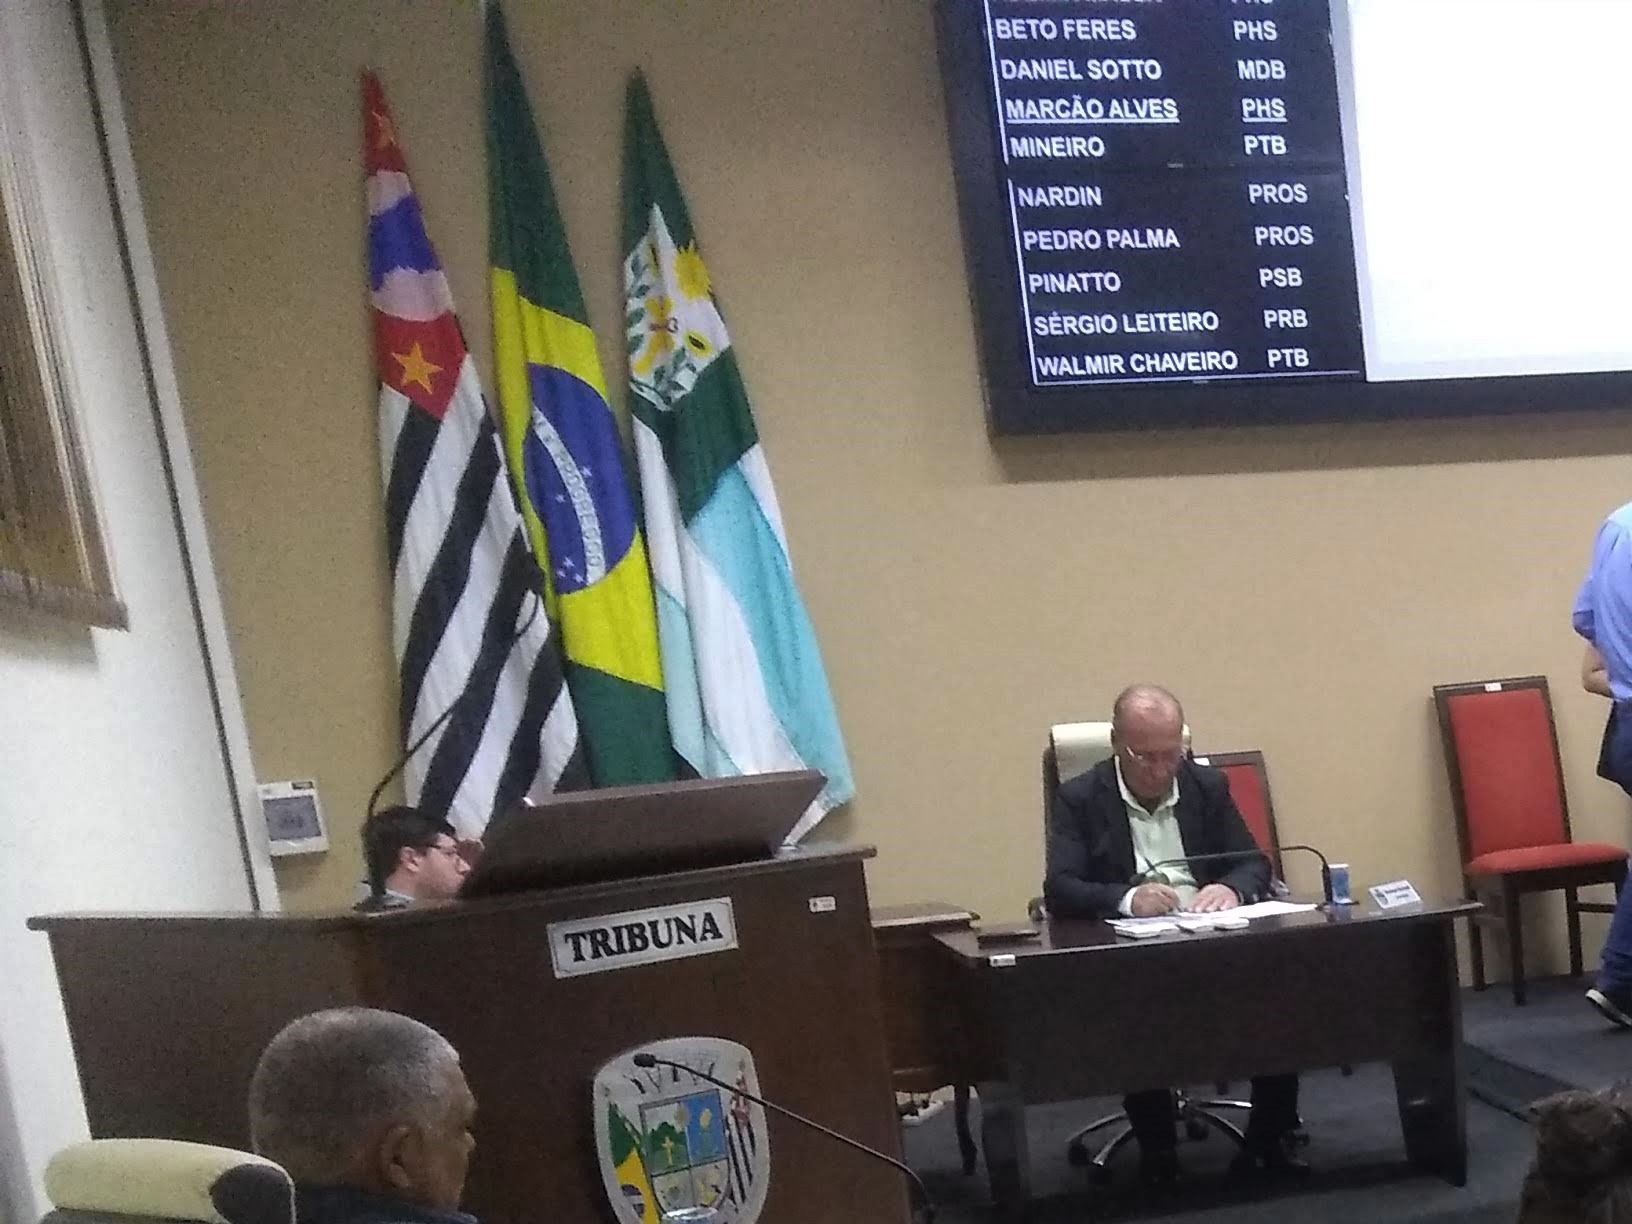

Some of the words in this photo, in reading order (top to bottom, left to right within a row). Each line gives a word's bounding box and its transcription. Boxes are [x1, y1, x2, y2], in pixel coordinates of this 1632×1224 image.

[995, 19, 1057, 40] BETO
[1064, 19, 1137, 40] FERES
[1233, 20, 1277, 40] PHS
[1000, 59, 1083, 80] DANIEL
[1087, 59, 1162, 80] SOTTO
[1238, 60, 1286, 79] MDB
[1006, 95, 1103, 119] MARCÃO
[1109, 99, 1179, 118] ALVES
[1242, 99, 1286, 118] PHS
[1010, 136, 1105, 157] MINEIRO
[1244, 136, 1286, 155] PTB
[1017, 186, 1102, 206] NARDIN
[1248, 184, 1308, 204] PROS
[1023, 229, 1100, 250] PEDRO
[1106, 228, 1180, 249] PALMA
[1255, 226, 1314, 246] PROS
[1028, 273, 1121, 293] PINATTO
[1259, 269, 1302, 288] PSB
[1034, 312, 1117, 336] SÉRGIO
[1122, 311, 1219, 333] LEITEIRO
[1264, 310, 1307, 328] PRB
[1036, 354, 1124, 375] WALMIR
[1130, 351, 1239, 373] CHAVEIRO
[1268, 349, 1309, 368] PTB
[564, 912, 723, 962] TRIBUNA
